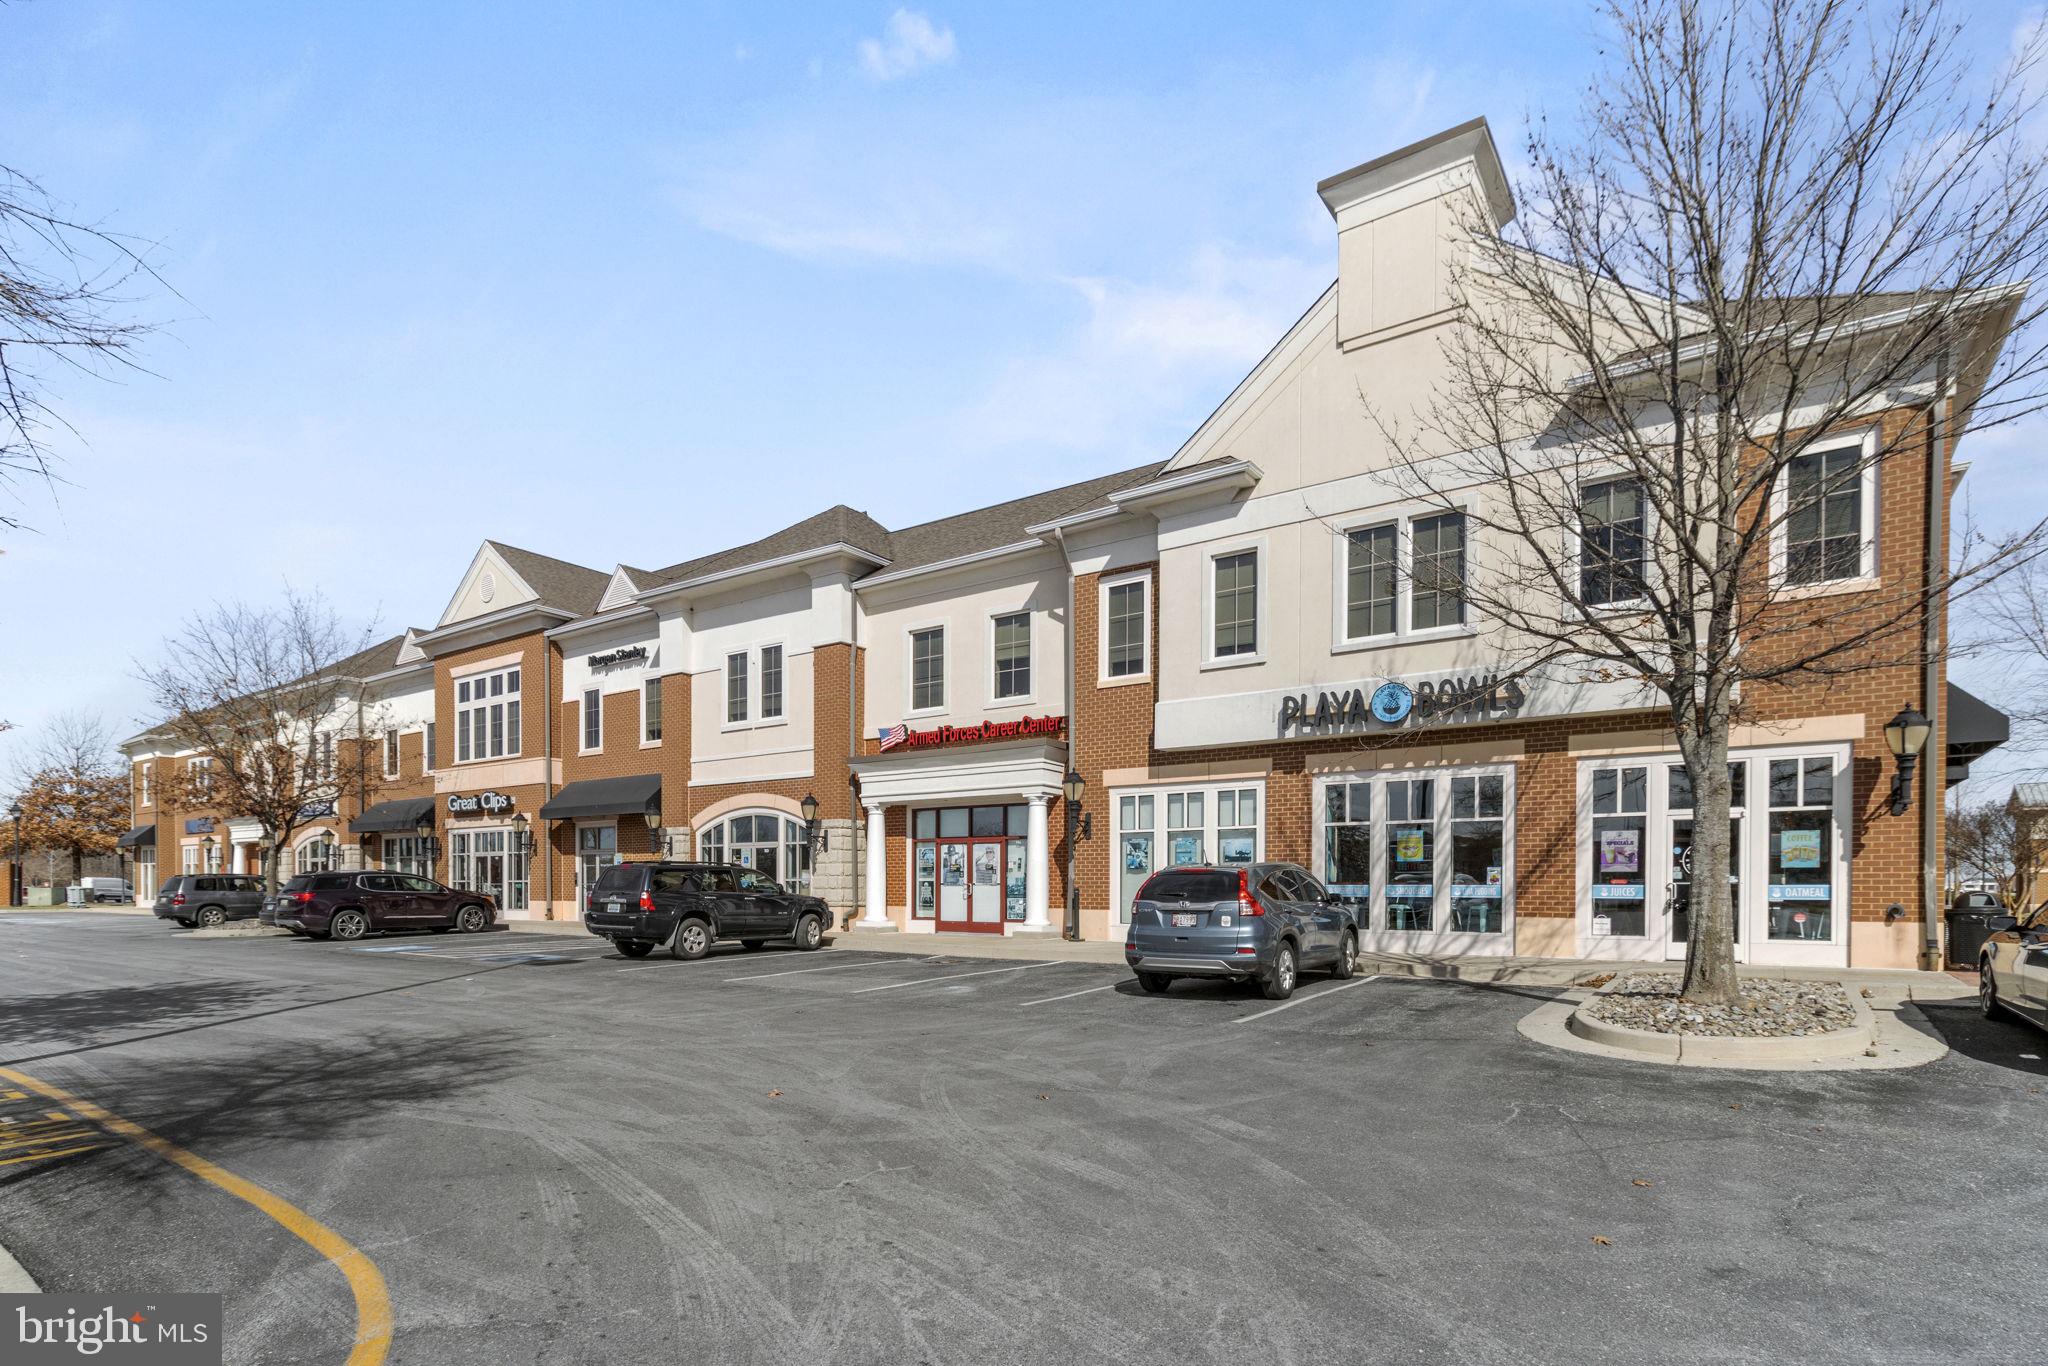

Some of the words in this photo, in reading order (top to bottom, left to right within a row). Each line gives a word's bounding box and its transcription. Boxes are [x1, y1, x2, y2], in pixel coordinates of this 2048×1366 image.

[588, 654, 617, 667] Morgan
[616, 645, 647, 661] Stanley
[1282, 688, 1368, 730] PLAYA
[1417, 673, 1525, 718] BOWLS
[907, 726, 941, 747] Armed
[942, 724, 979, 742] Forces
[981, 719, 1018, 738] Career
[1020, 714, 1061, 734] Center
[448, 795, 478, 811] Great
[481, 791, 507, 813] Clips
[1610, 887, 1636, 897] JUICES
[1785, 887, 1825, 897] OATMEAL
